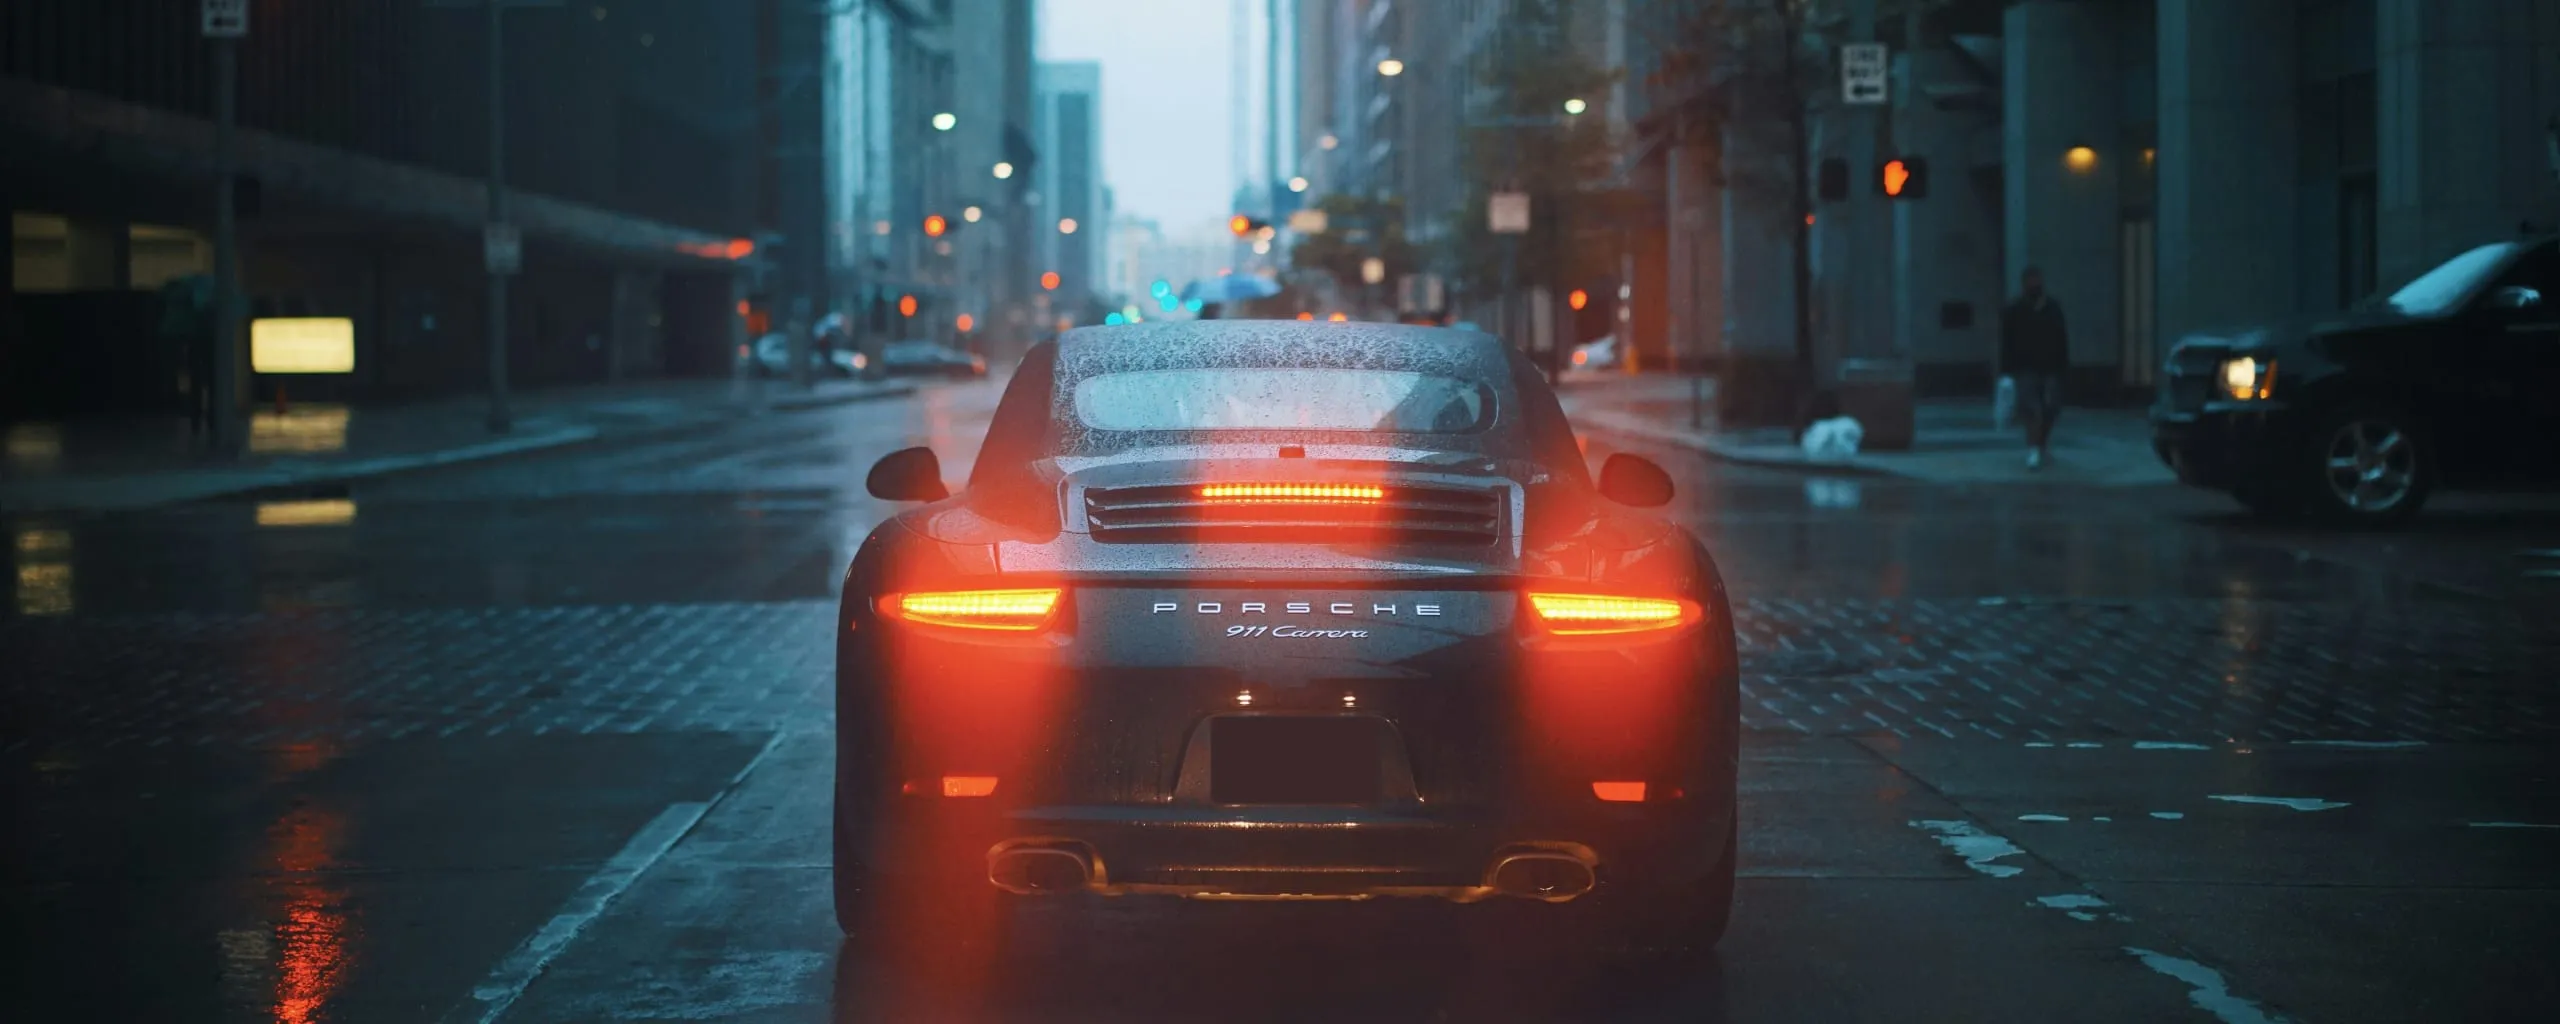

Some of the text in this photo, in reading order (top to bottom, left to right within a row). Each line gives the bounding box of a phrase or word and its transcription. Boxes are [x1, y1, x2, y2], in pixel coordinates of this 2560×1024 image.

[1152, 602, 1441, 616] PORSCHE
[1226, 625, 1369, 638] 911 Carrera
